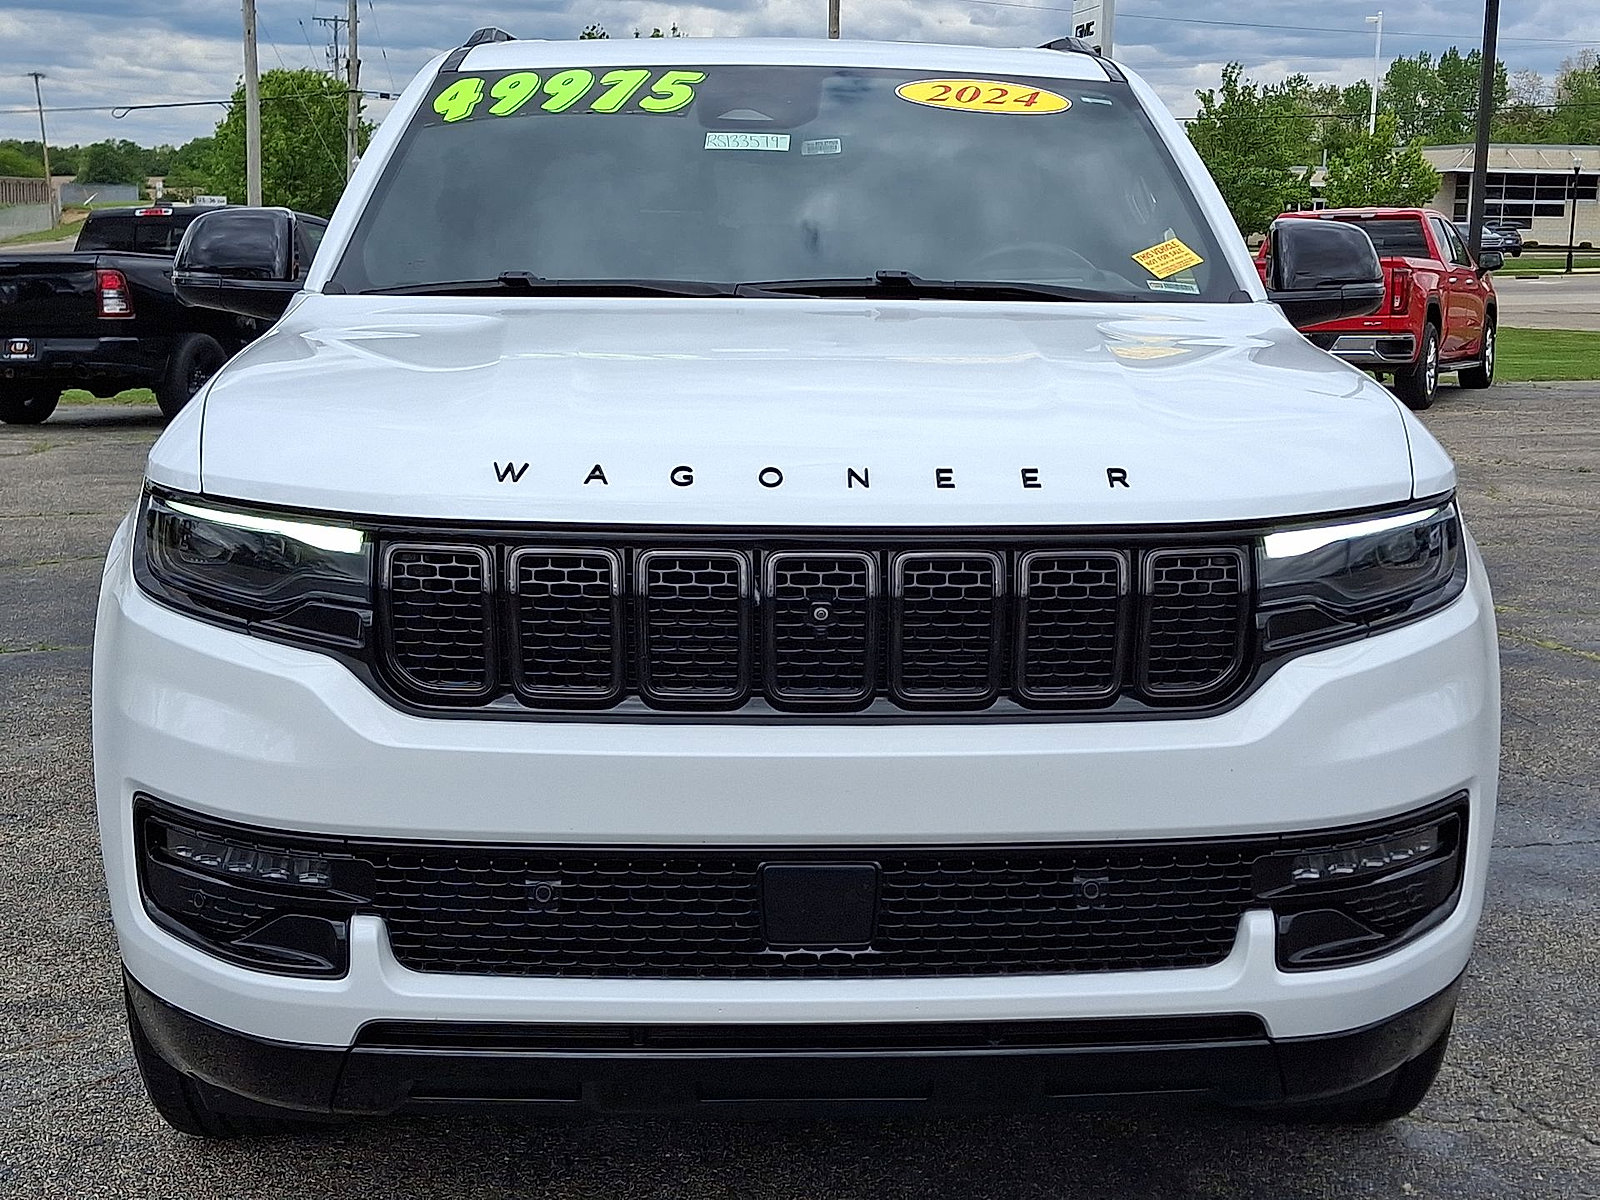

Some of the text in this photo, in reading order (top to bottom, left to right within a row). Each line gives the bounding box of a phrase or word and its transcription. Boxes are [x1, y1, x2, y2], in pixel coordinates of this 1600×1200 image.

[432, 69, 706, 123] 49975
[927, 84, 1041, 107] 2024
[493, 461, 1130, 488] WAGONEER
